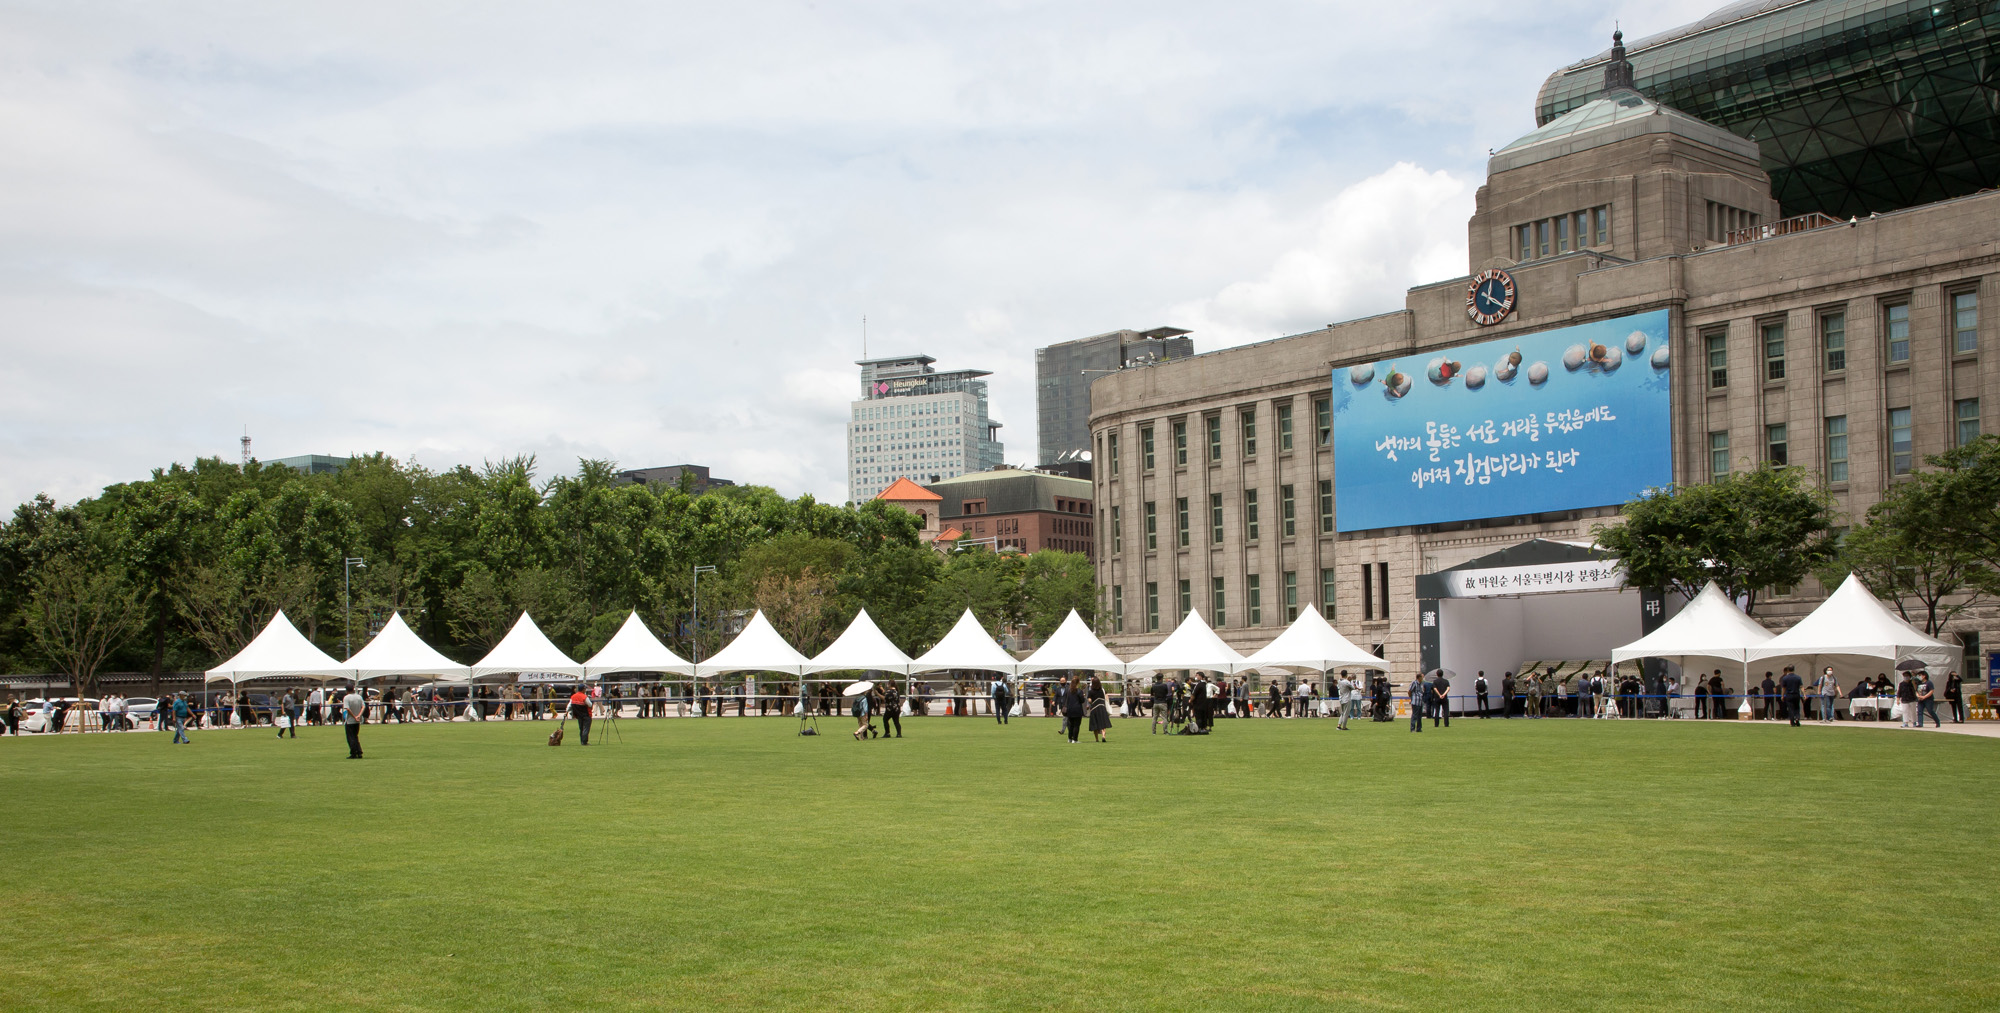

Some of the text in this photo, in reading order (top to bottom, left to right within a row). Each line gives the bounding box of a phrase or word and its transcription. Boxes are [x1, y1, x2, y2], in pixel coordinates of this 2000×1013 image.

[893, 378, 927, 388] Heungkuk
[1375, 405, 1616, 462] 냇가의 돌들은 서로 거리를 두었음에도
[1411, 448, 1580, 489] 이어져 징검다리가 된다
[1465, 568, 1611, 589] 故 박원순 서울특별시장 분향소
[1646, 601, 1660, 617] 弔
[1422, 611, 1436, 628] 謹
